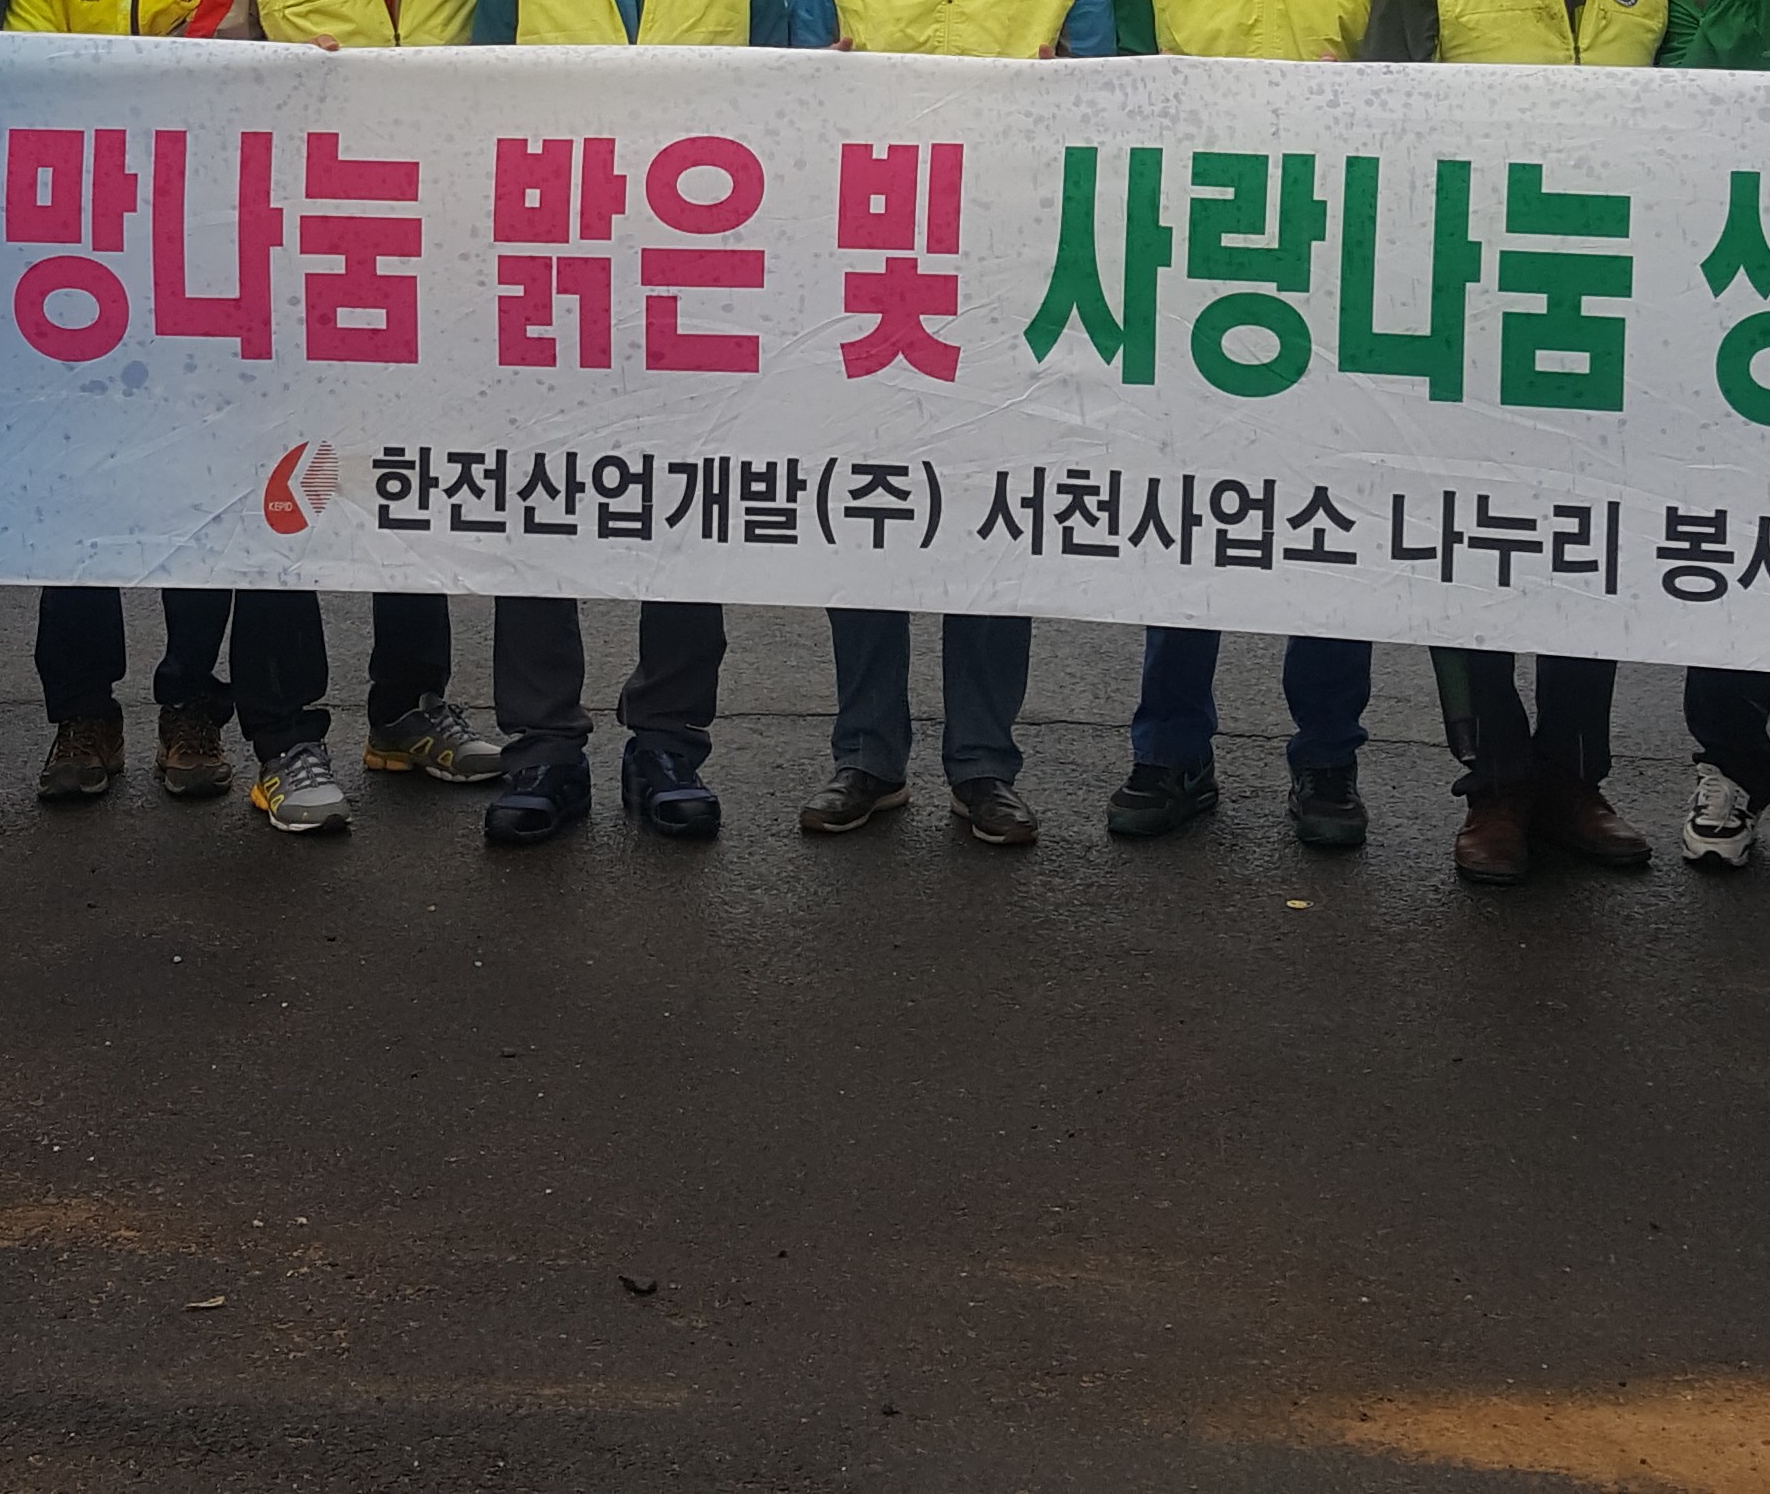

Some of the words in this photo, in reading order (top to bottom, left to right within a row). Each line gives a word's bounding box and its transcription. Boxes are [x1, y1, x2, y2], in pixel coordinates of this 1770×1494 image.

[492, 135, 766, 374] 밝은
[836, 142, 964, 383] 빛
[1023, 146, 1633, 412] 사랑나눔
[371, 444, 944, 551] 한전산업개발(주)
[975, 465, 1358, 571] 서천사업소
[1390, 489, 1622, 596] 나누리
